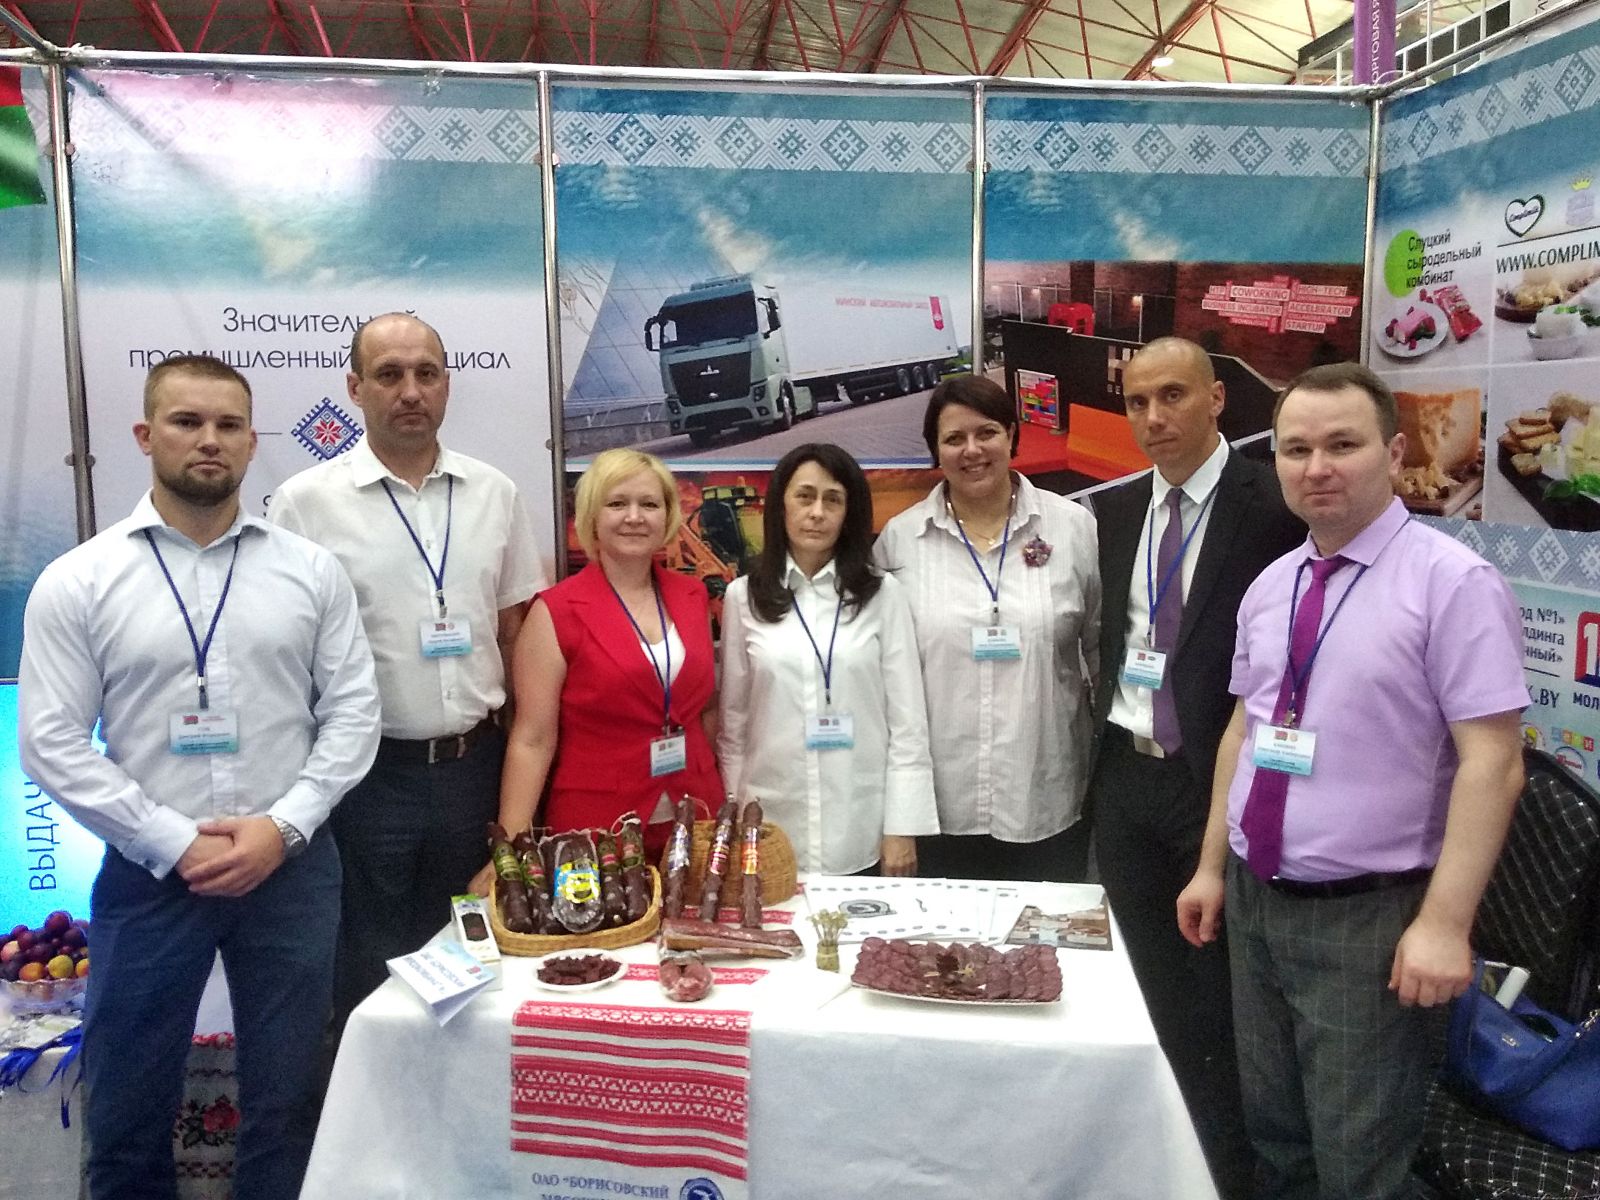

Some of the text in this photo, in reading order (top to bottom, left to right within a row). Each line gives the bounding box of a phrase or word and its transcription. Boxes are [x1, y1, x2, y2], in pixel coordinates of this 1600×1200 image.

[1372, 9, 1380, 84] ОРГОВАЯ
[1408, 228, 1451, 253] Слуцкий
[1407, 242, 1482, 271] сыродельный
[1406, 270, 1454, 288] комбинат
[1232, 286, 1288, 300] COWORKING
[223, 307, 418, 332] Значитель
[1290, 303, 1352, 315] ACCELERATOR
[1286, 321, 1325, 331] STARTUP
[129, 345, 351, 369] пршленный
[1522, 626, 1565, 646] лдинга
[24, 781, 60, 891] ВЫДАЧ
[532, 1172, 560, 1186] ОАО
